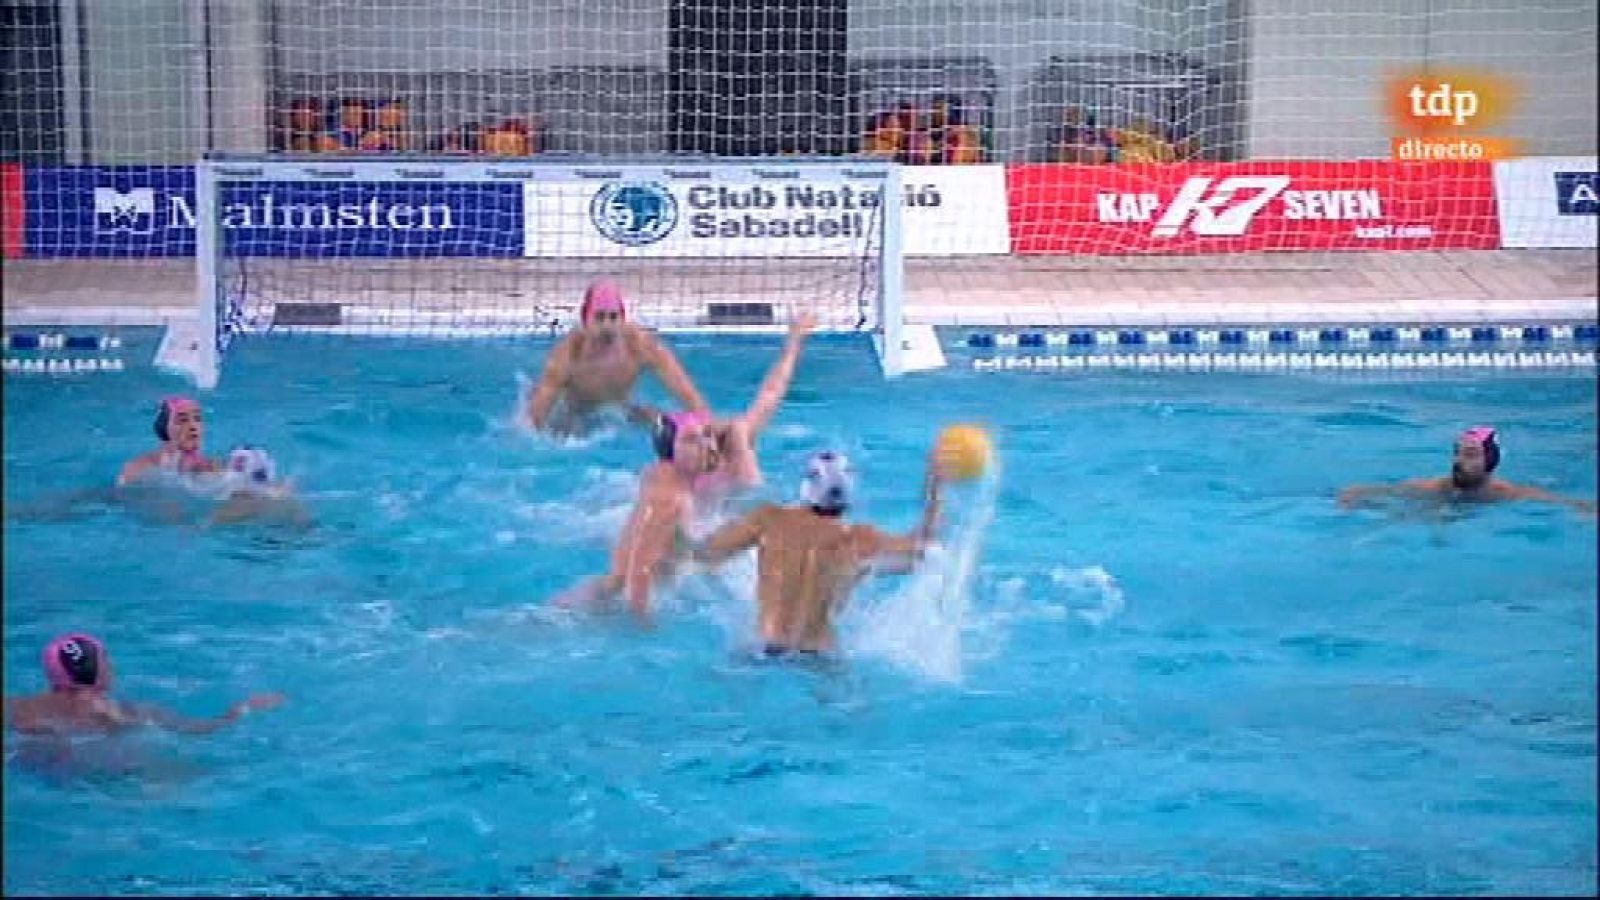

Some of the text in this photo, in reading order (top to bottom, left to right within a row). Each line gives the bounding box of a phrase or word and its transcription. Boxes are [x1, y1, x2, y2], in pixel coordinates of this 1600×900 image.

[688, 184, 942, 210] Club Nataió
[1097, 192, 1159, 223] KAP
[1284, 189, 1383, 220] SEVEN
[690, 213, 863, 238] Sabadell
